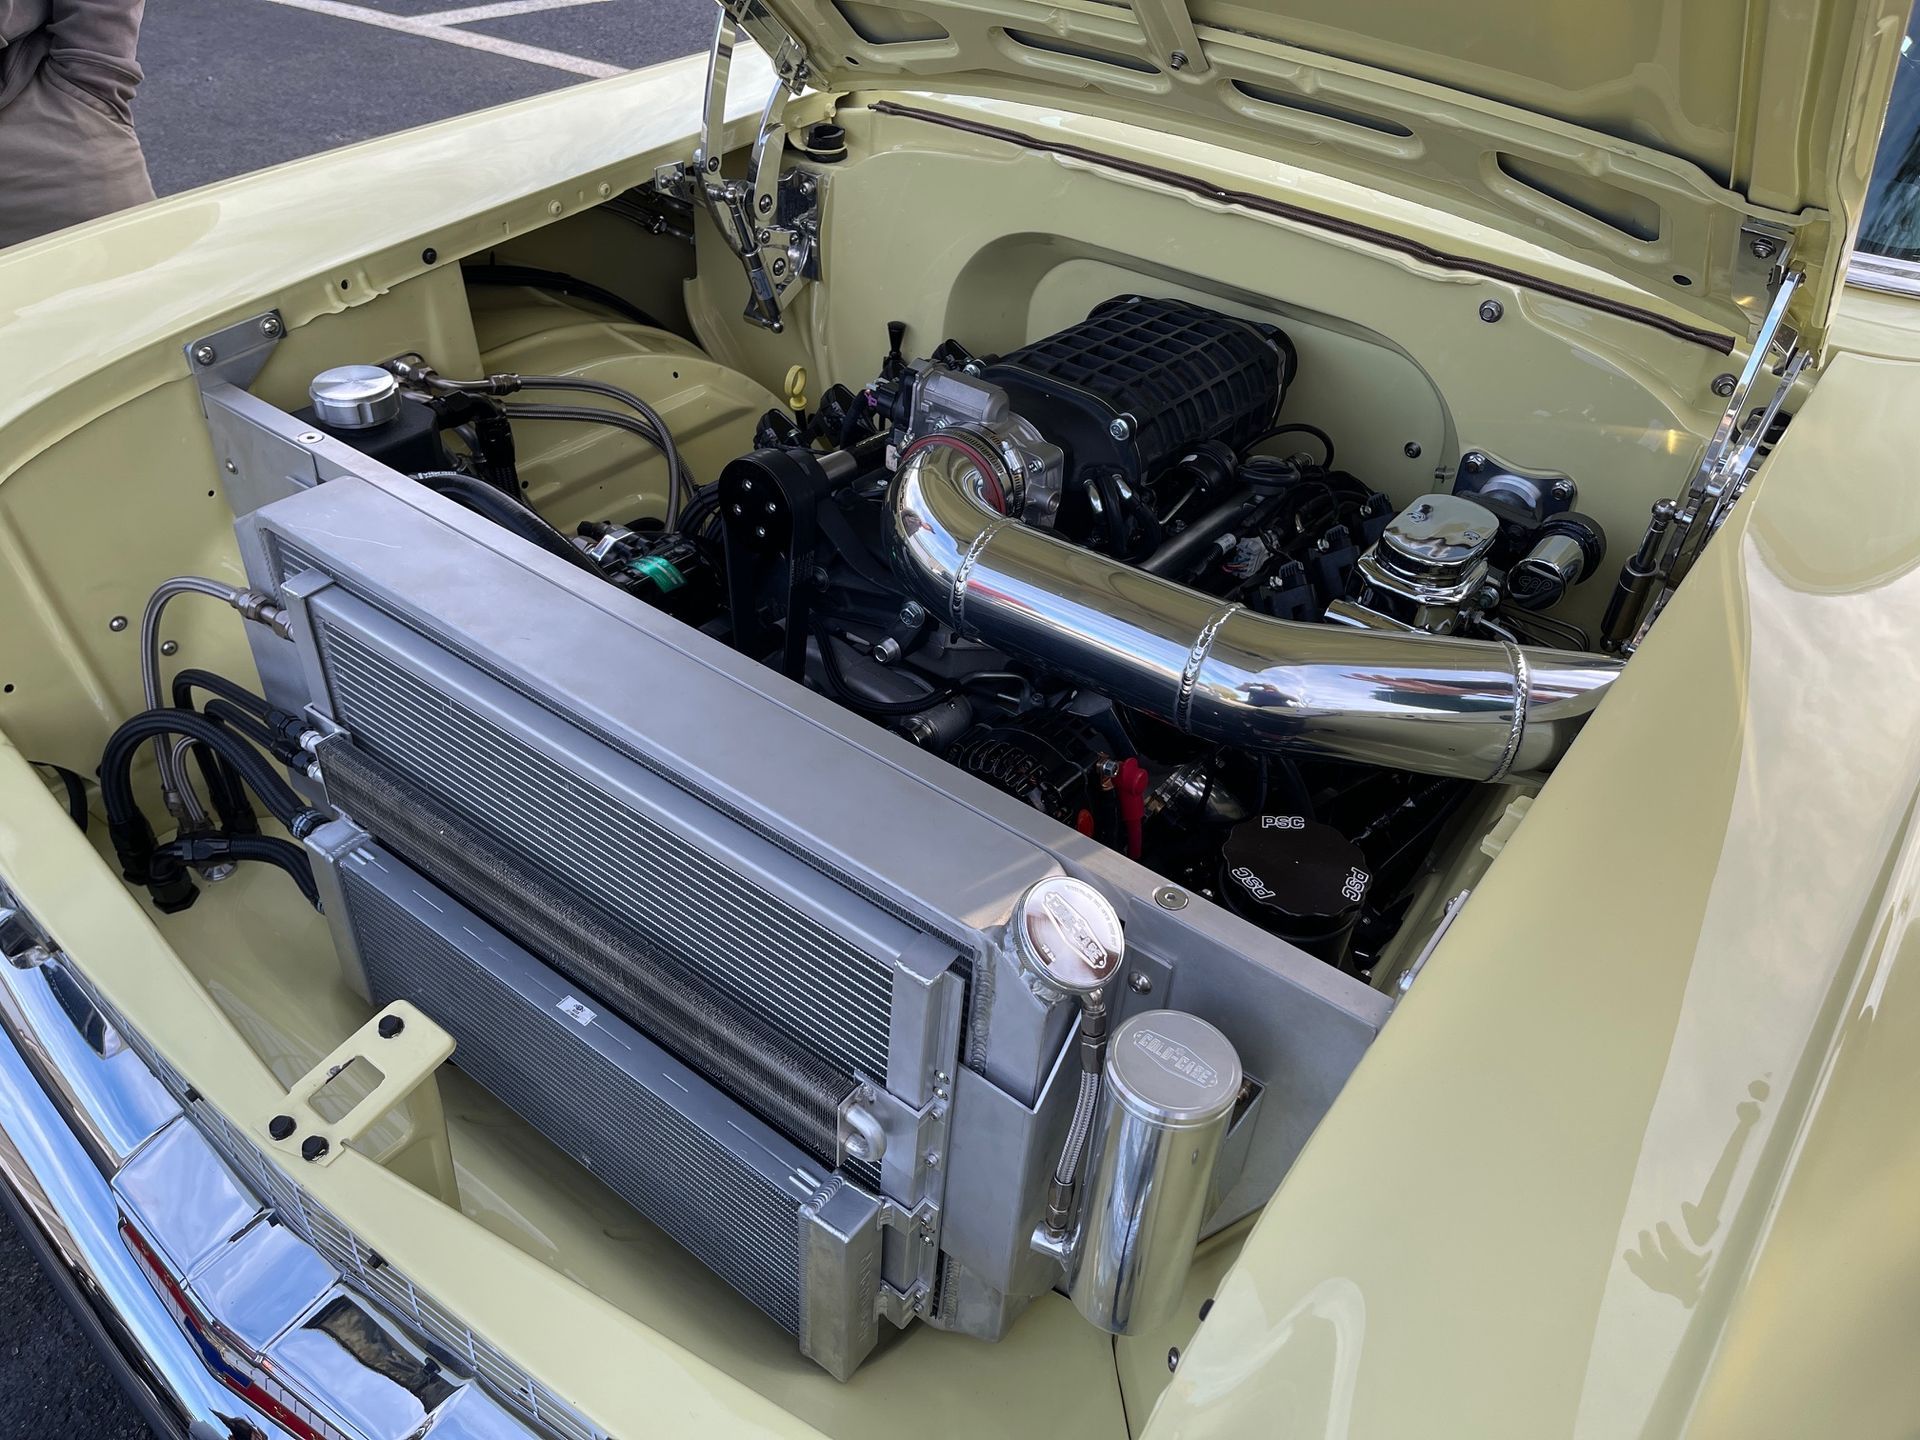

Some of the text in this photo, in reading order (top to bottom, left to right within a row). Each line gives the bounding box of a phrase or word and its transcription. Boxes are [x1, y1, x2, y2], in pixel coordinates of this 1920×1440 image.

[1261, 815, 1305, 829] PSC
[1231, 867, 1276, 899] PSC
[1341, 867, 1370, 901] PSC
[1138, 1033, 1213, 1084] COLD-CASE
